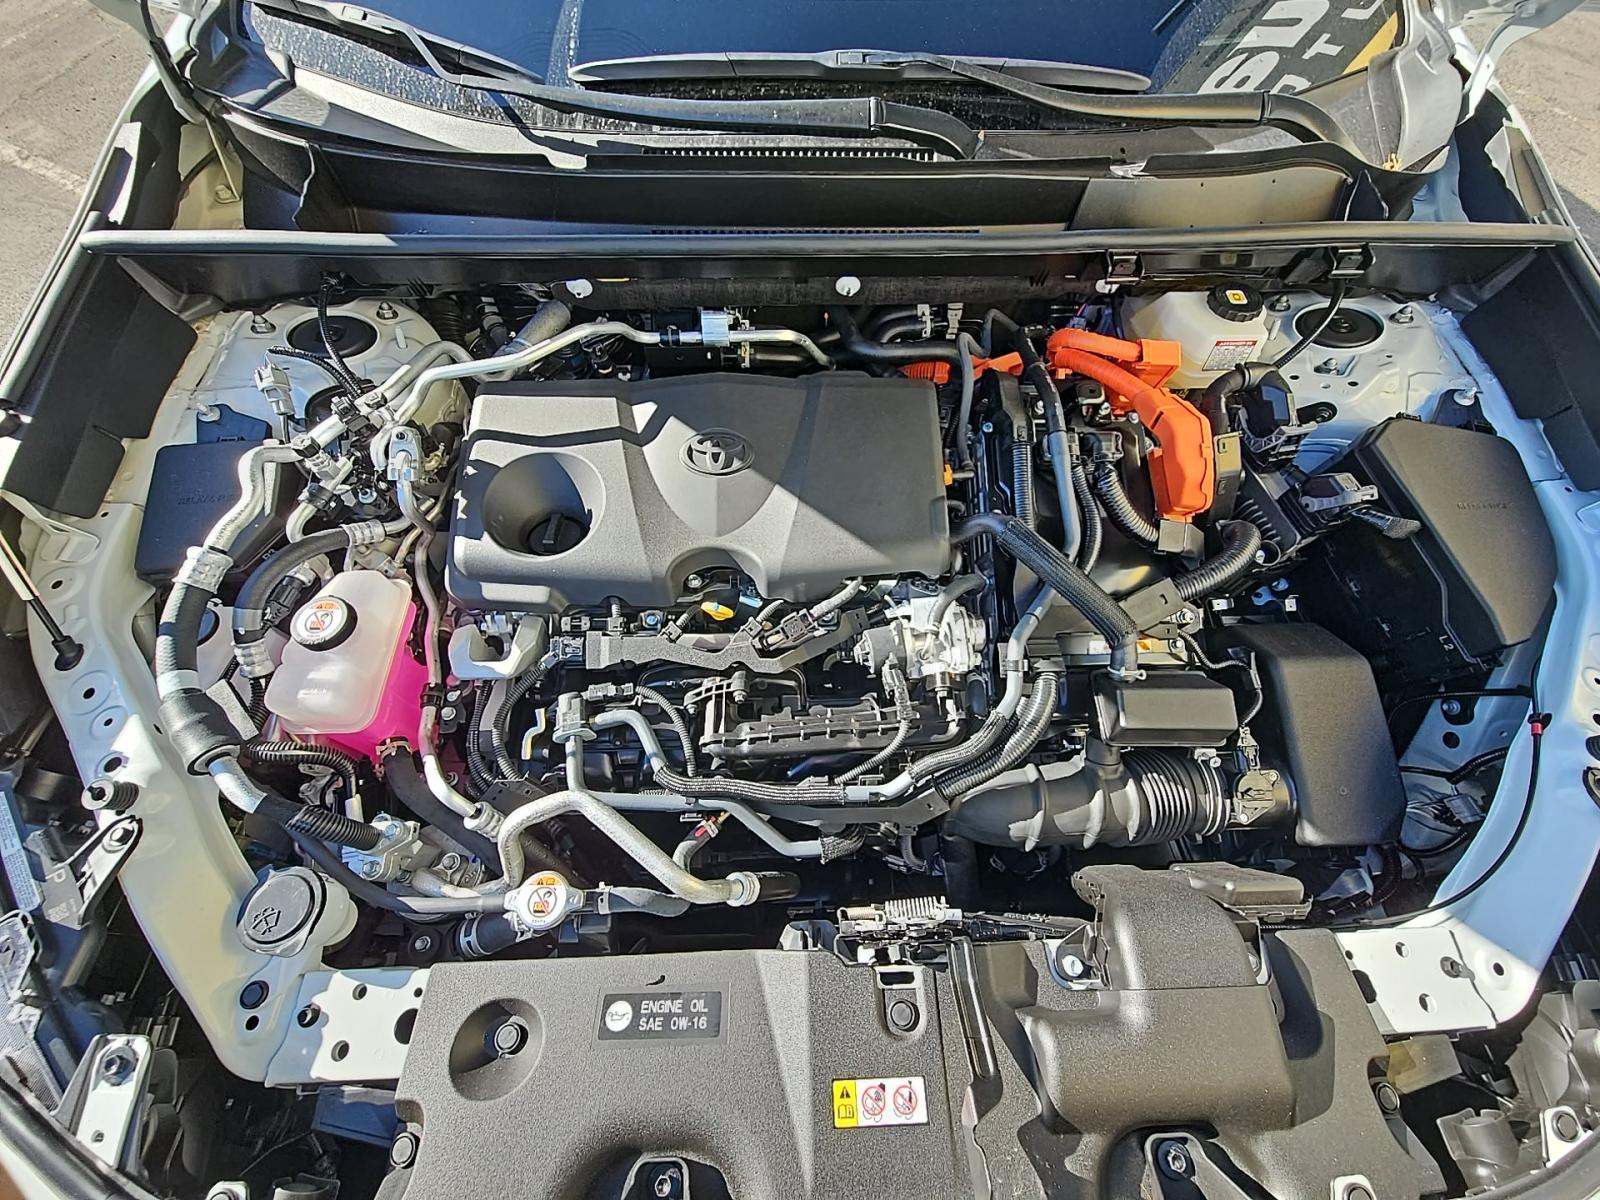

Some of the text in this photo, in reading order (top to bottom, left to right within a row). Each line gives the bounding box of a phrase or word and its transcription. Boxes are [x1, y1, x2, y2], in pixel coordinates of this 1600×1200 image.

[640, 999, 709, 1014] ENGINE OIL
[638, 1016, 708, 1031] SAE 0W-16
